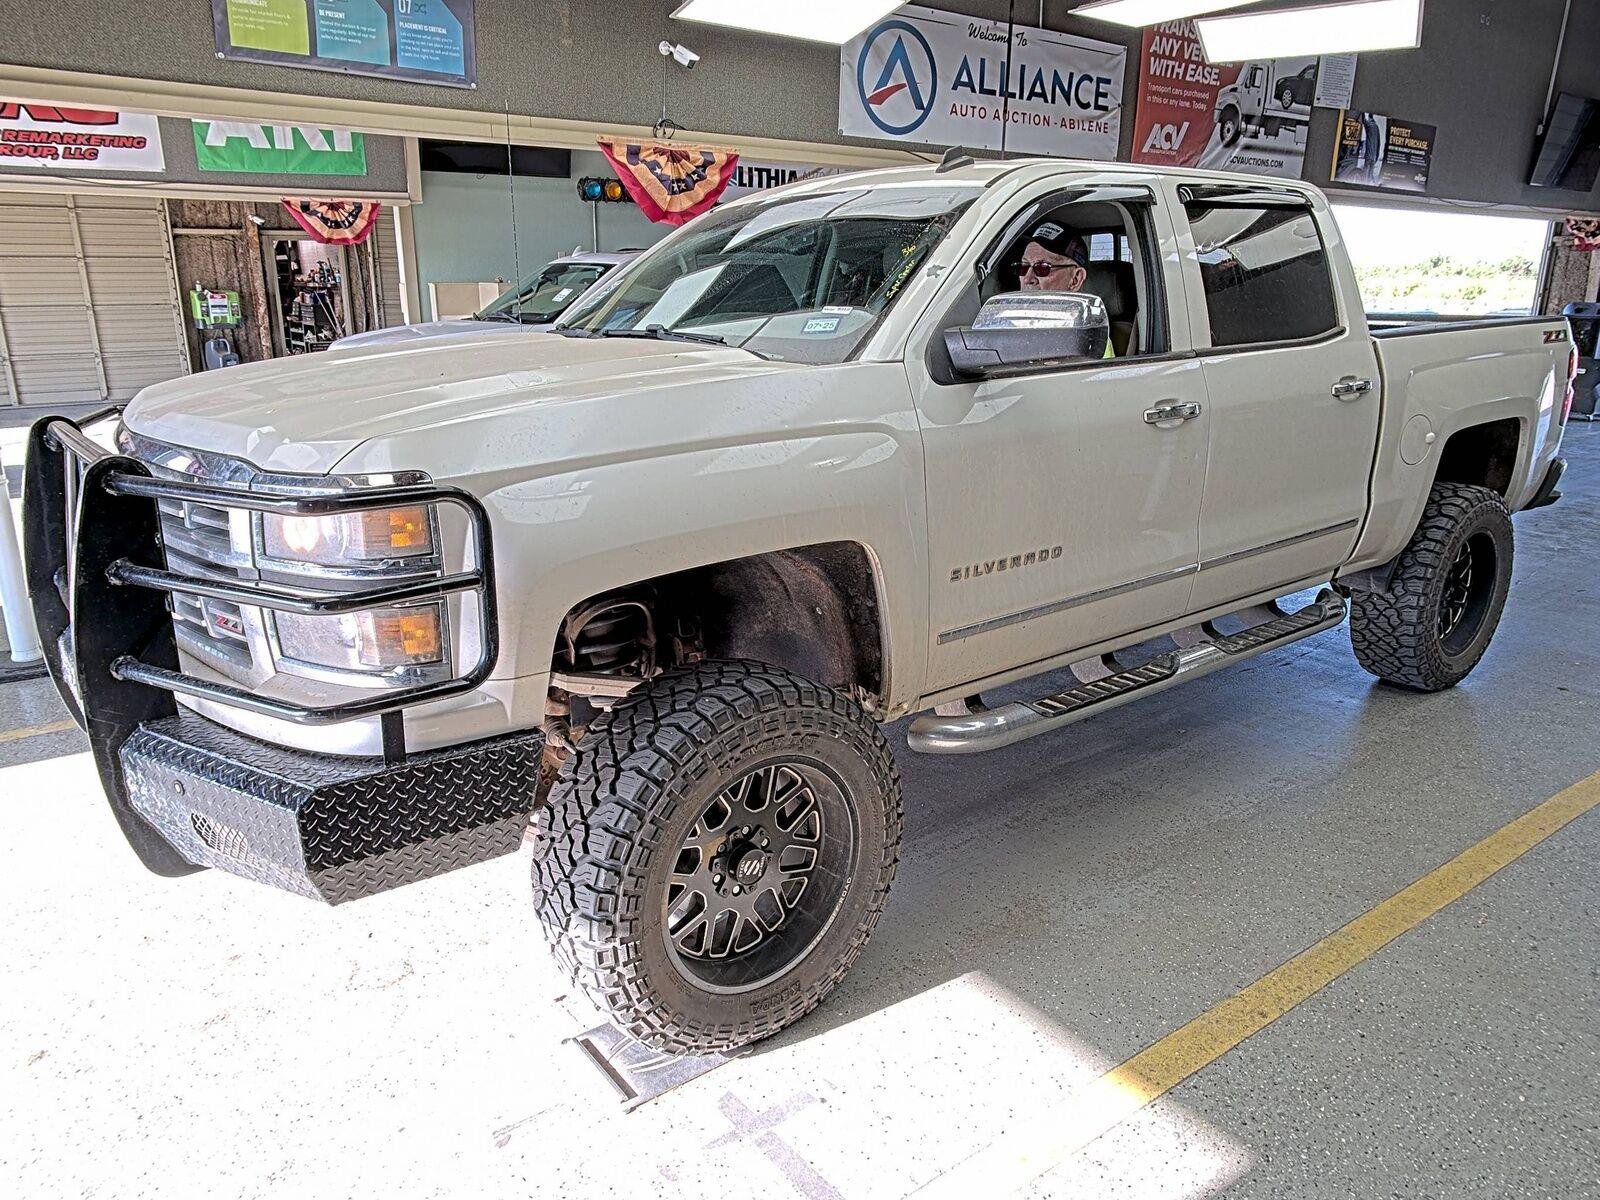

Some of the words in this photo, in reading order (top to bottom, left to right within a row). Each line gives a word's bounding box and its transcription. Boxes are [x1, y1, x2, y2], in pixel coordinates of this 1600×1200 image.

[325, 10, 345, 19] PRESENT
[399, 21, 424, 31] PLACEMENT
[428, 26, 447, 35] CRITICAL
[1016, 31, 1028, 47] To
[1149, 35, 1182, 57] ANY
[1149, 56, 1185, 79] WITH
[1185, 63, 1220, 87] EASE.
[951, 54, 1112, 112] ALLIANCE
[1147, 82, 1172, 94] Transport
[1171, 87, 1183, 96] cars
[1183, 89, 1210, 99] purchased
[1146, 93, 1152, 102] in
[1152, 95, 1162, 104] this
[1169, 99, 1178, 107] any
[1192, 100, 1207, 111] Today.
[950, 103, 987, 119] AUTO
[992, 108, 1051, 127] AUCTION
[1060, 117, 1109, 134] ABILENE
[1, 128, 147, 149] REMARKETING
[1141, 121, 1190, 153] ACV
[1389, 135, 1405, 146] EVERY
[1405, 137, 1429, 150] PURCHASE
[1390, 126, 1412, 138] PROTECT
[62, 146, 99, 160] LLC
[738, 165, 797, 188] LITHIA
[950, 545, 1063, 583] SILVERADO
[750, 980, 801, 1017] KENDA
